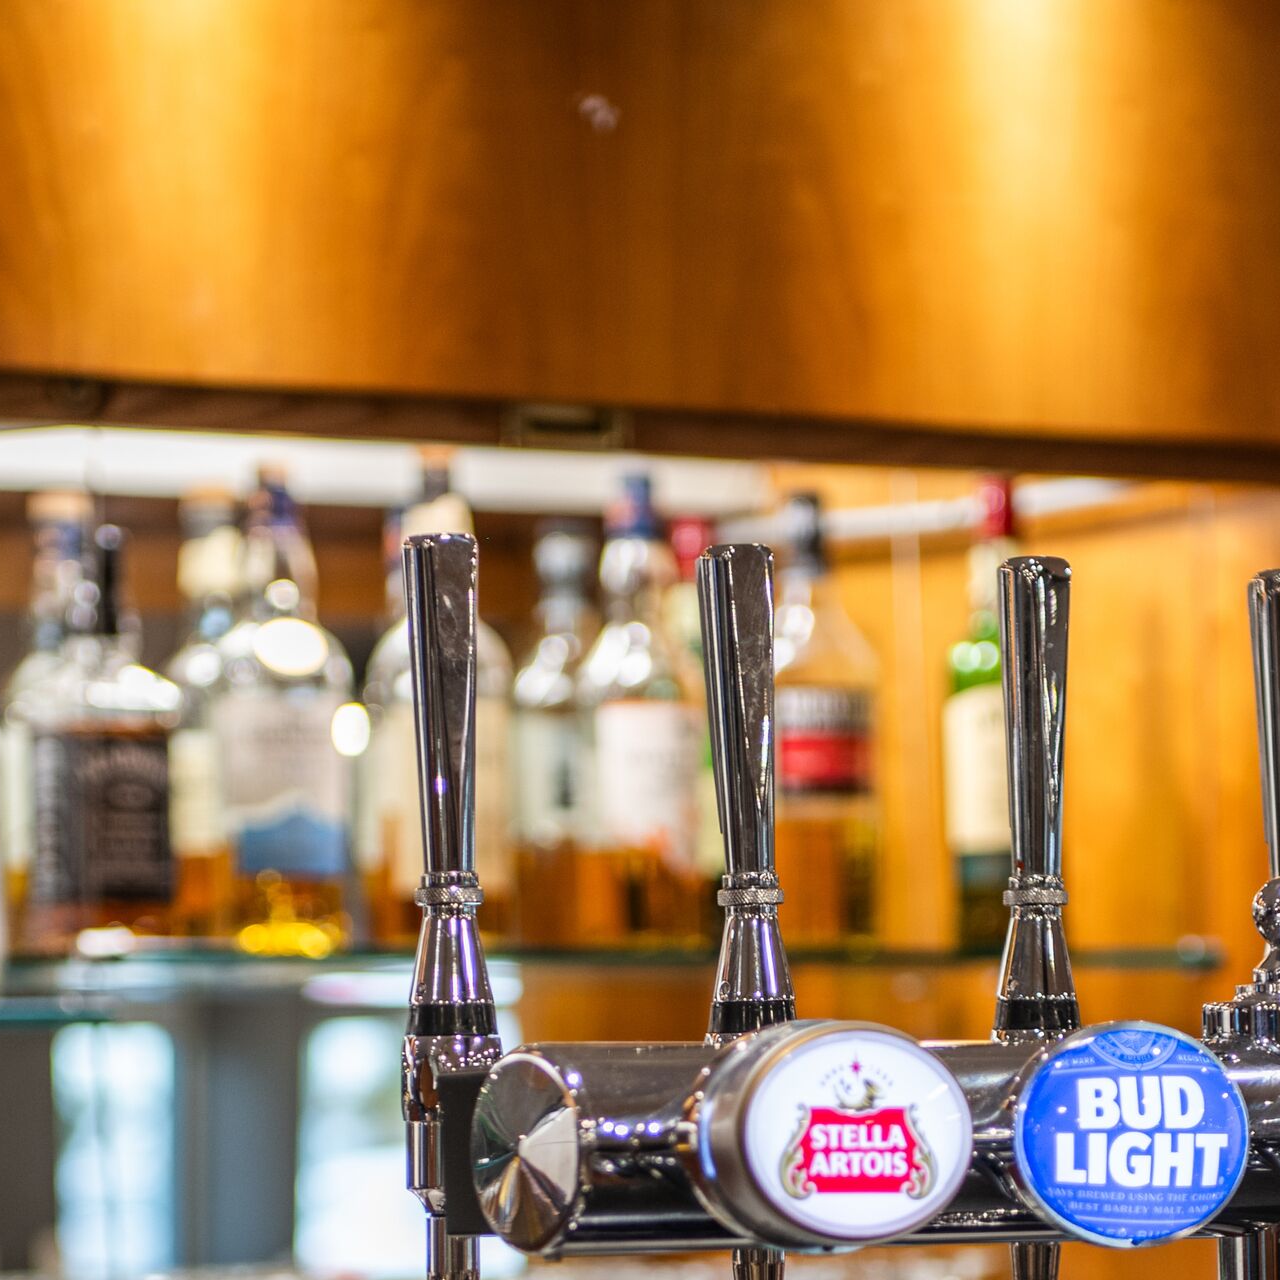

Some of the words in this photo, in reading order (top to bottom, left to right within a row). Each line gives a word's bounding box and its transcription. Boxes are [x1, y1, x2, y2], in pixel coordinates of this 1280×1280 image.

[1077, 1075, 1205, 1130] BUD
[809, 1123, 907, 1150] STELLA
[808, 1151, 909, 1178] ARTOIS
[1055, 1131, 1229, 1187] LIGHT
[1069, 1201, 1099, 1211] BEST
[1103, 1204, 1149, 1214] BARLEY
[1077, 1189, 1126, 1199] BREWED
[1128, 1191, 1164, 1201] USING
[1167, 1193, 1190, 1201] THE
